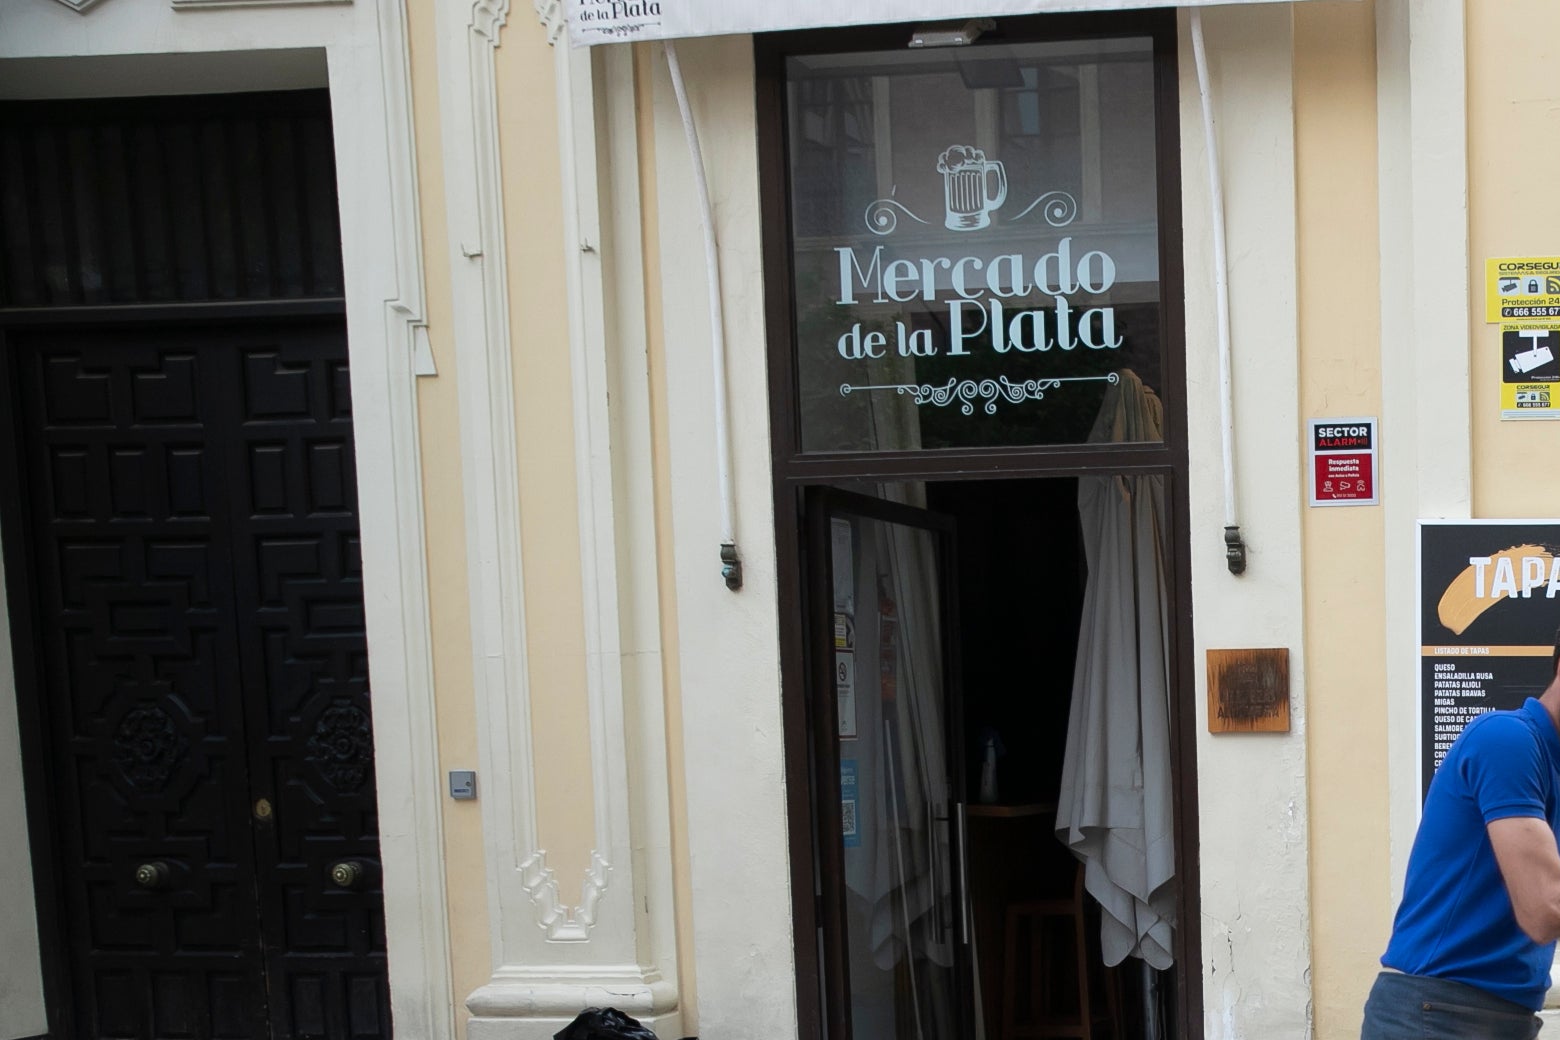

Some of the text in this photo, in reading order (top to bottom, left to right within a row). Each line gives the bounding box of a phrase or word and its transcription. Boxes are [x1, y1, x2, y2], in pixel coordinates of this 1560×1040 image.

[580, 10, 594, 21] de
[597, 9, 609, 20] la
[612, 0, 661, 19] Plata
[834, 237, 1116, 304] Mercado
[1513, 308, 1529, 316] 666
[837, 295, 1123, 360] de la Plata
[1318, 427, 1367, 437] SECTOR
[1319, 438, 1357, 446] ALARM
[1434, 664, 1455, 672] QUESO
[1434, 698, 1455, 706] MIGAS
